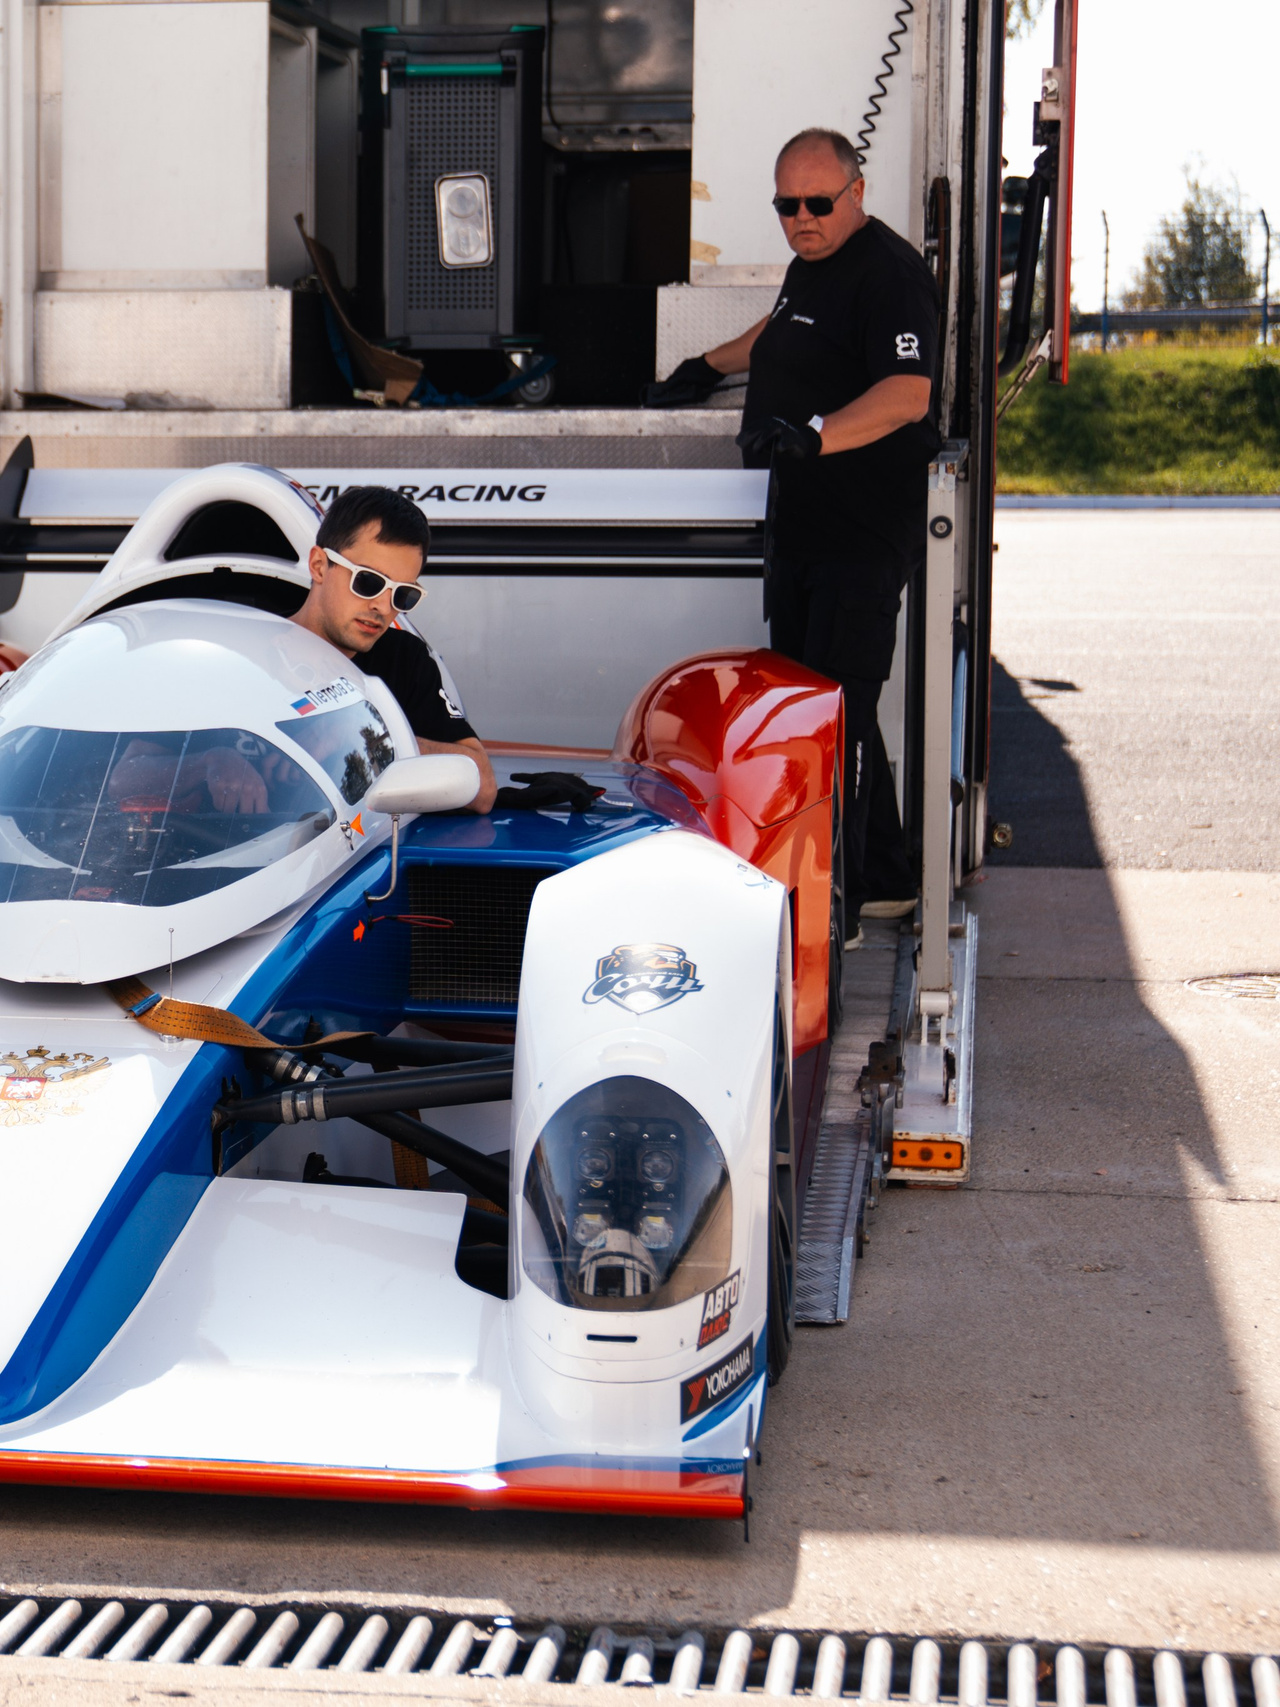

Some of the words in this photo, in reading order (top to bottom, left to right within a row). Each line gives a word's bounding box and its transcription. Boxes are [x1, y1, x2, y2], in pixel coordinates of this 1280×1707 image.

[398, 485, 547, 502] RACING
[304, 683, 348, 706] Петров
[706, 1346, 750, 1399] YOKOHAMA
